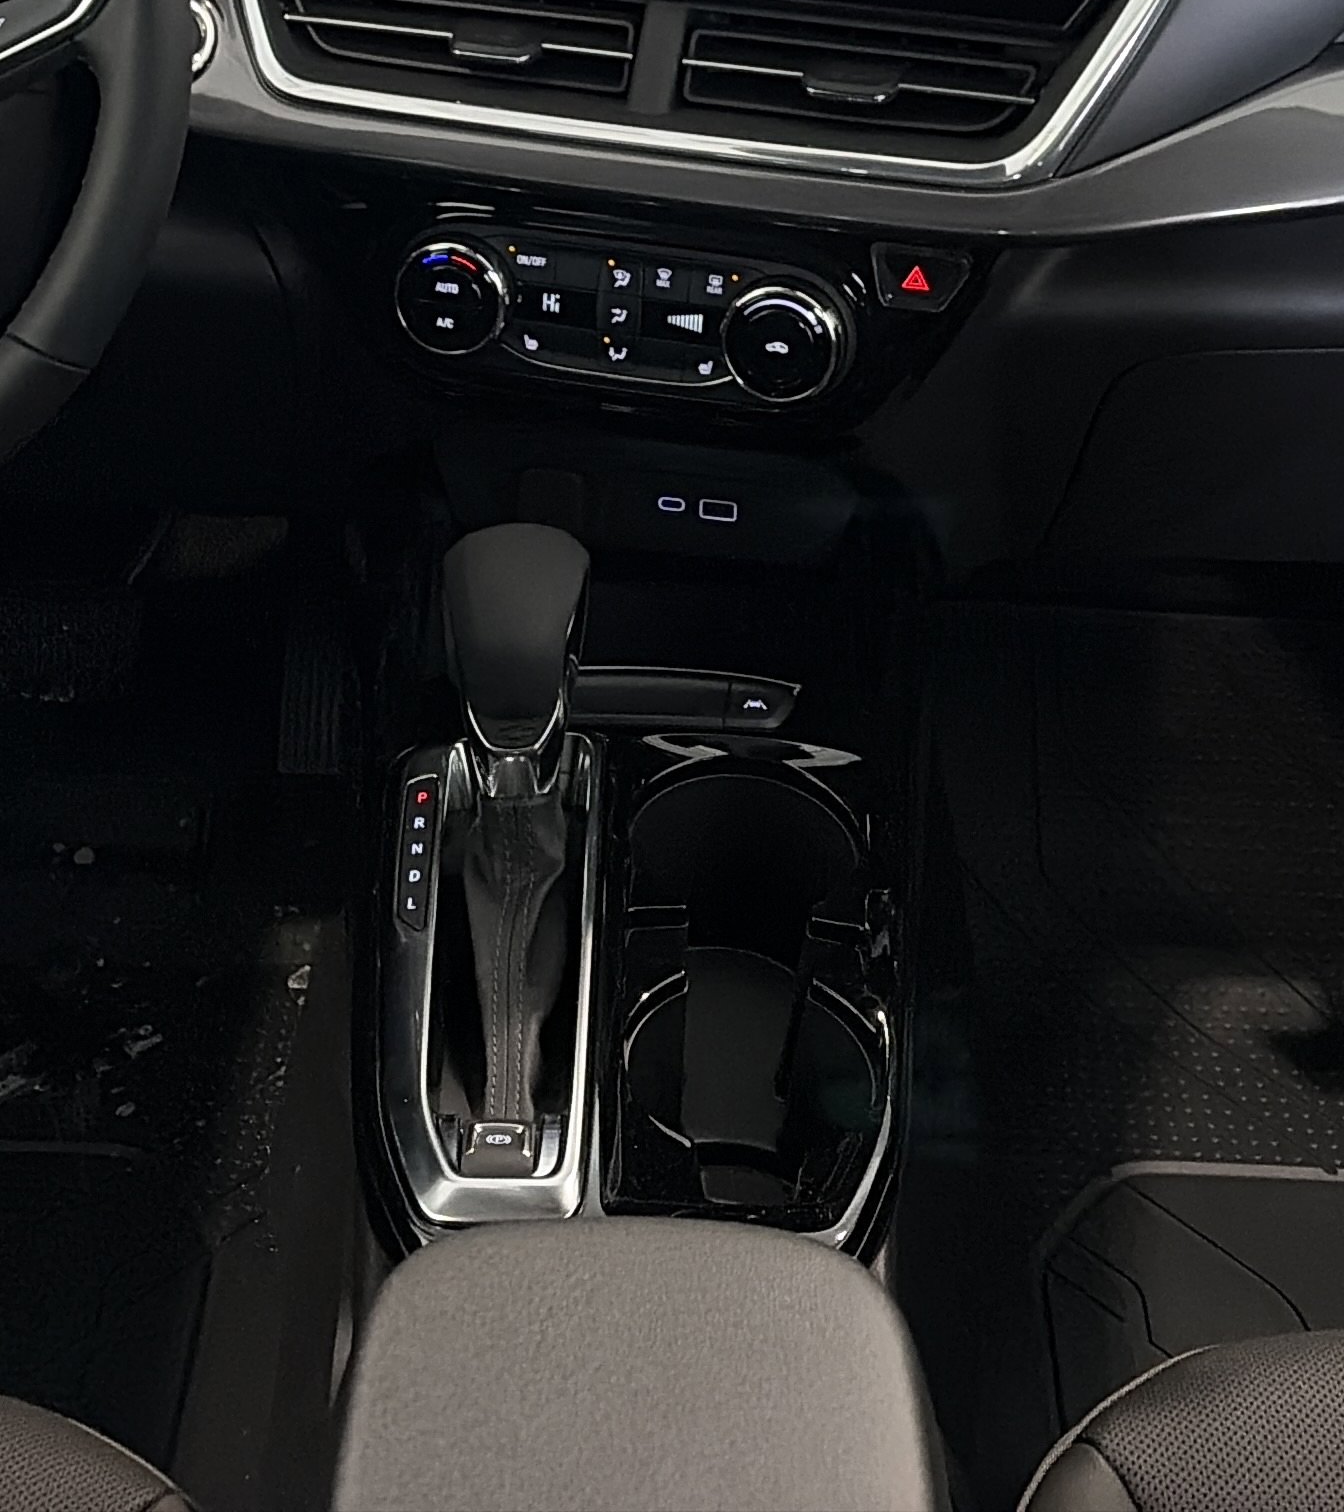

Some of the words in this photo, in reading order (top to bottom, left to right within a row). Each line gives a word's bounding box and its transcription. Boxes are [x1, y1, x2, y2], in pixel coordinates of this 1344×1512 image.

[516, 254, 547, 267] ON/OFF
[435, 281, 459, 295] AUTO
[542, 292, 561, 313] Hi
[436, 316, 454, 329] A/C
[417, 791, 428, 804] P
[413, 816, 425, 829] R
[411, 842, 424, 855] N
[408, 869, 421, 883] D
[406, 896, 417, 910] L
